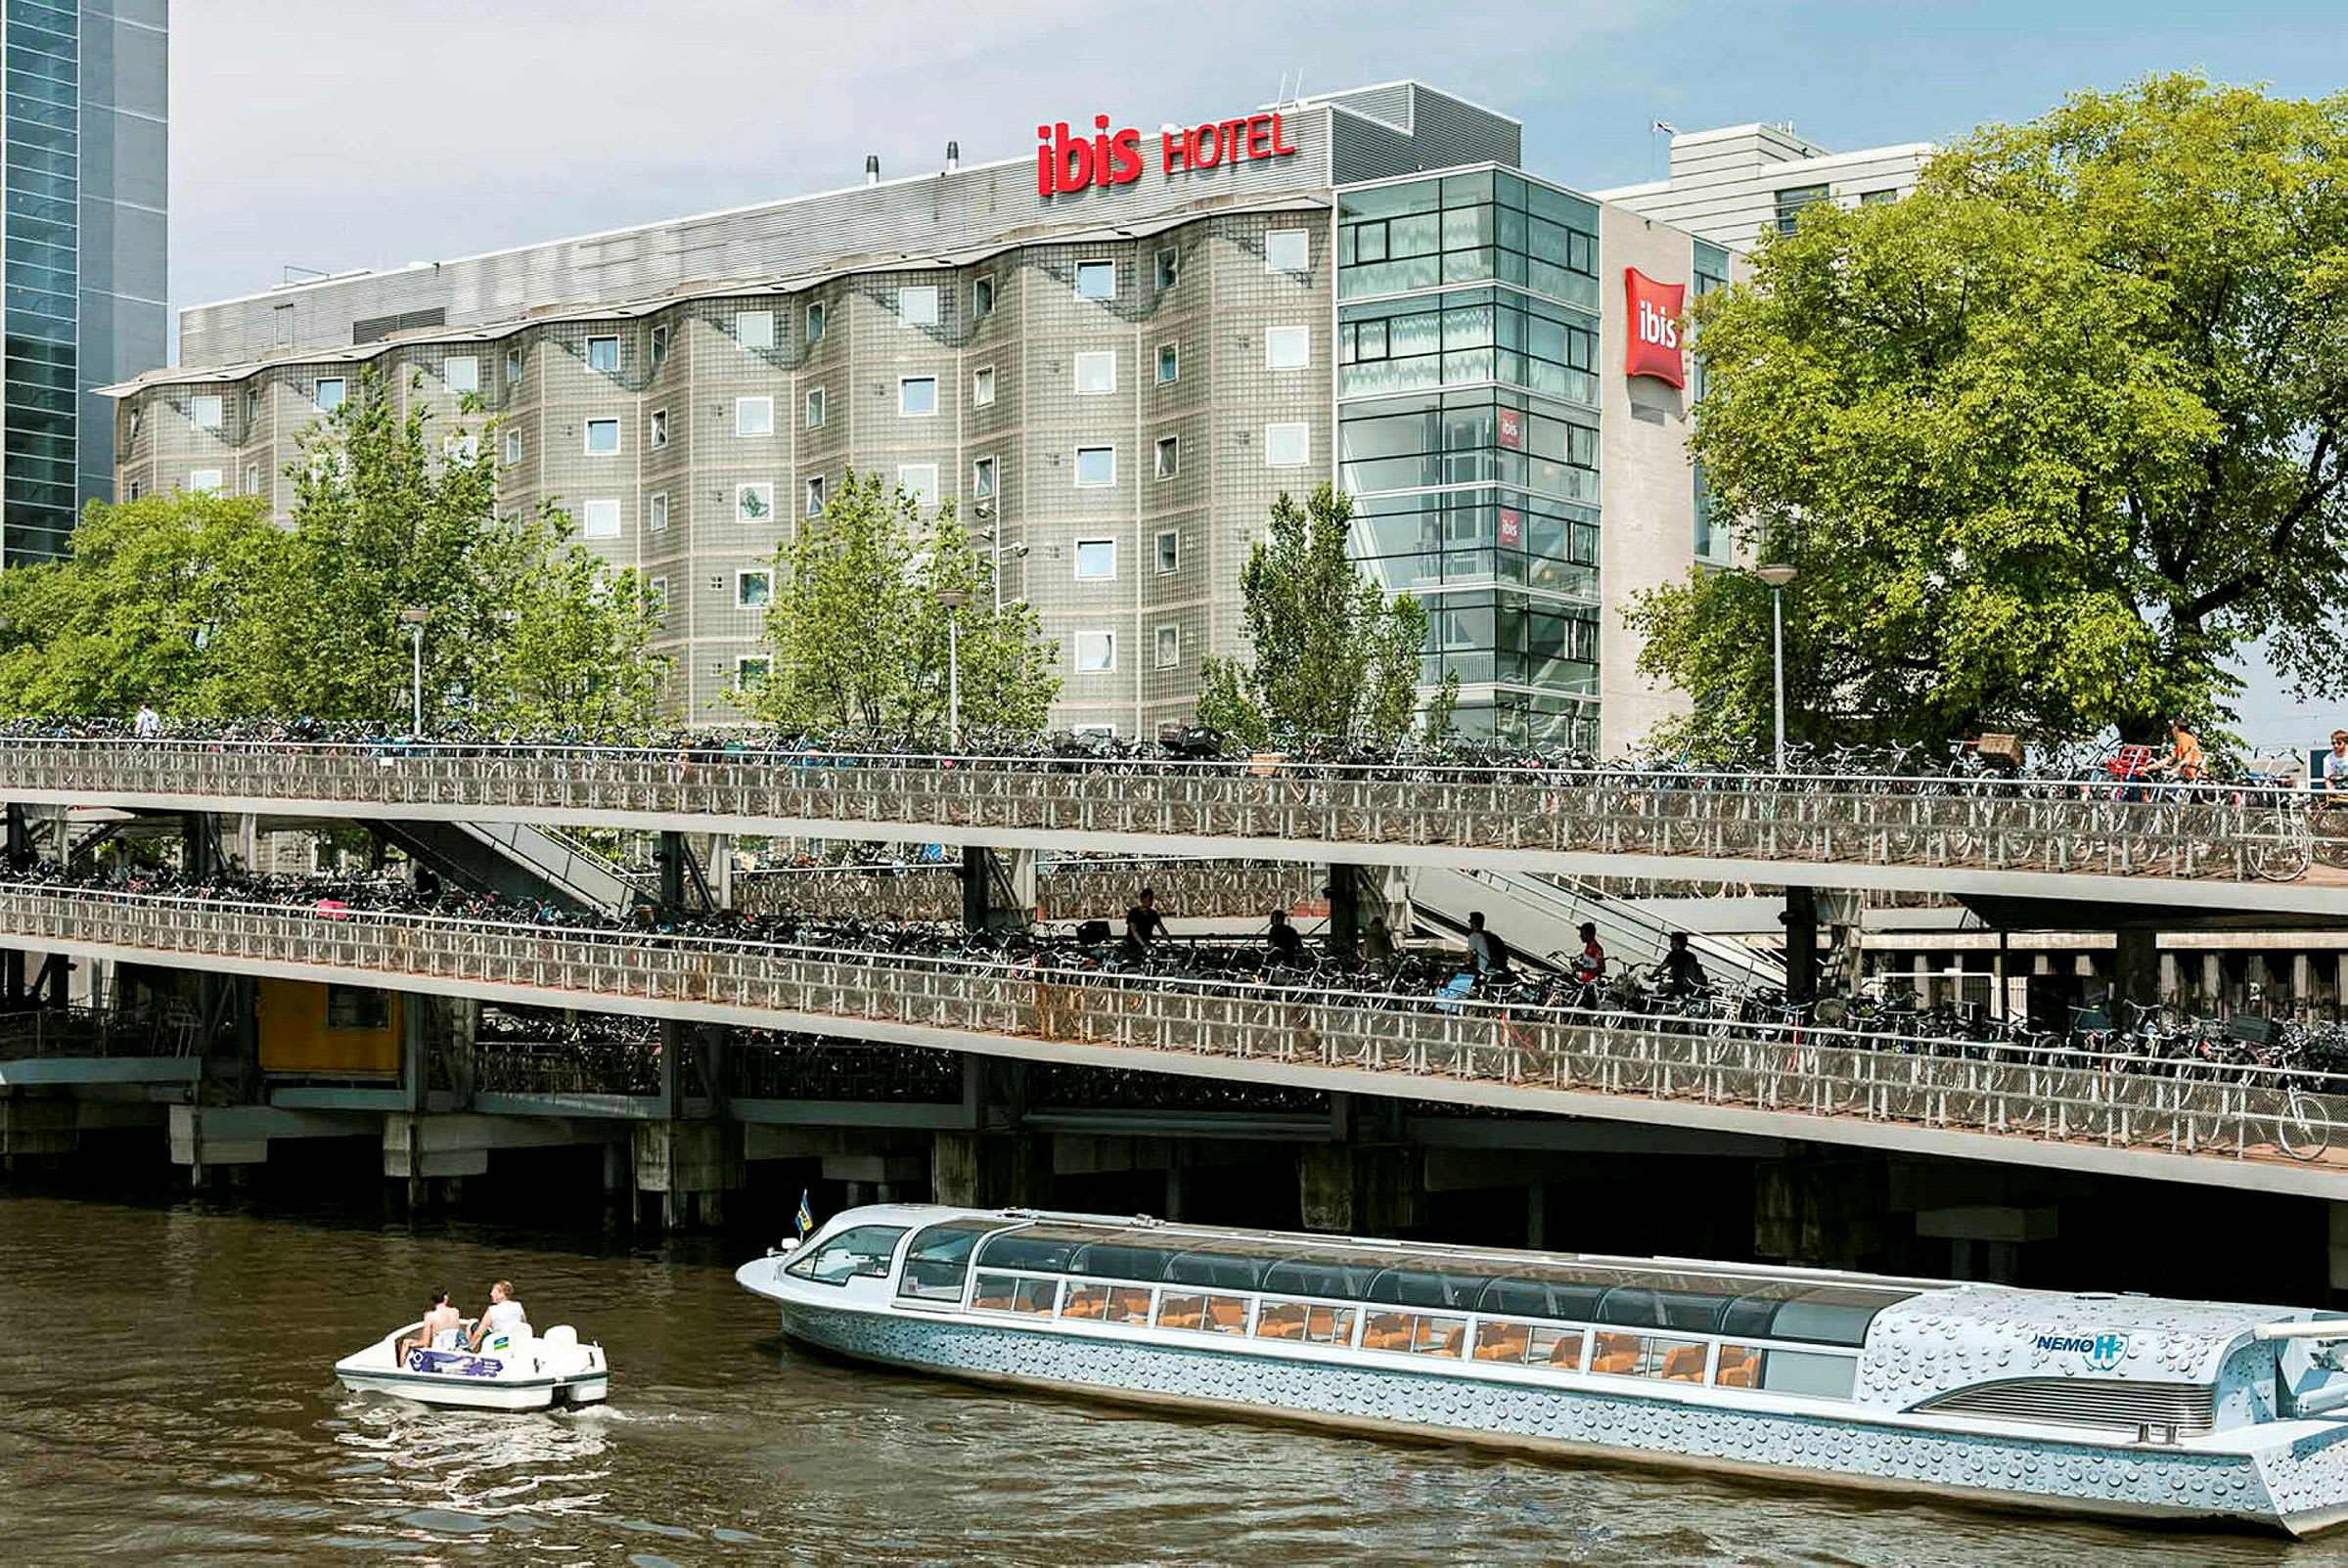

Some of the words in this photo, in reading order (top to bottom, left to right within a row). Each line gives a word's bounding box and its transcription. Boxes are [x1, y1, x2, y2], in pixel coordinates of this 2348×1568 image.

[1038, 114, 1144, 196] ibis
[1162, 112, 1297, 173] HOTEL
[1640, 299, 1677, 349] ibis
[1502, 419, 1517, 436] ibis
[2037, 1334, 2094, 1353] NEMO
